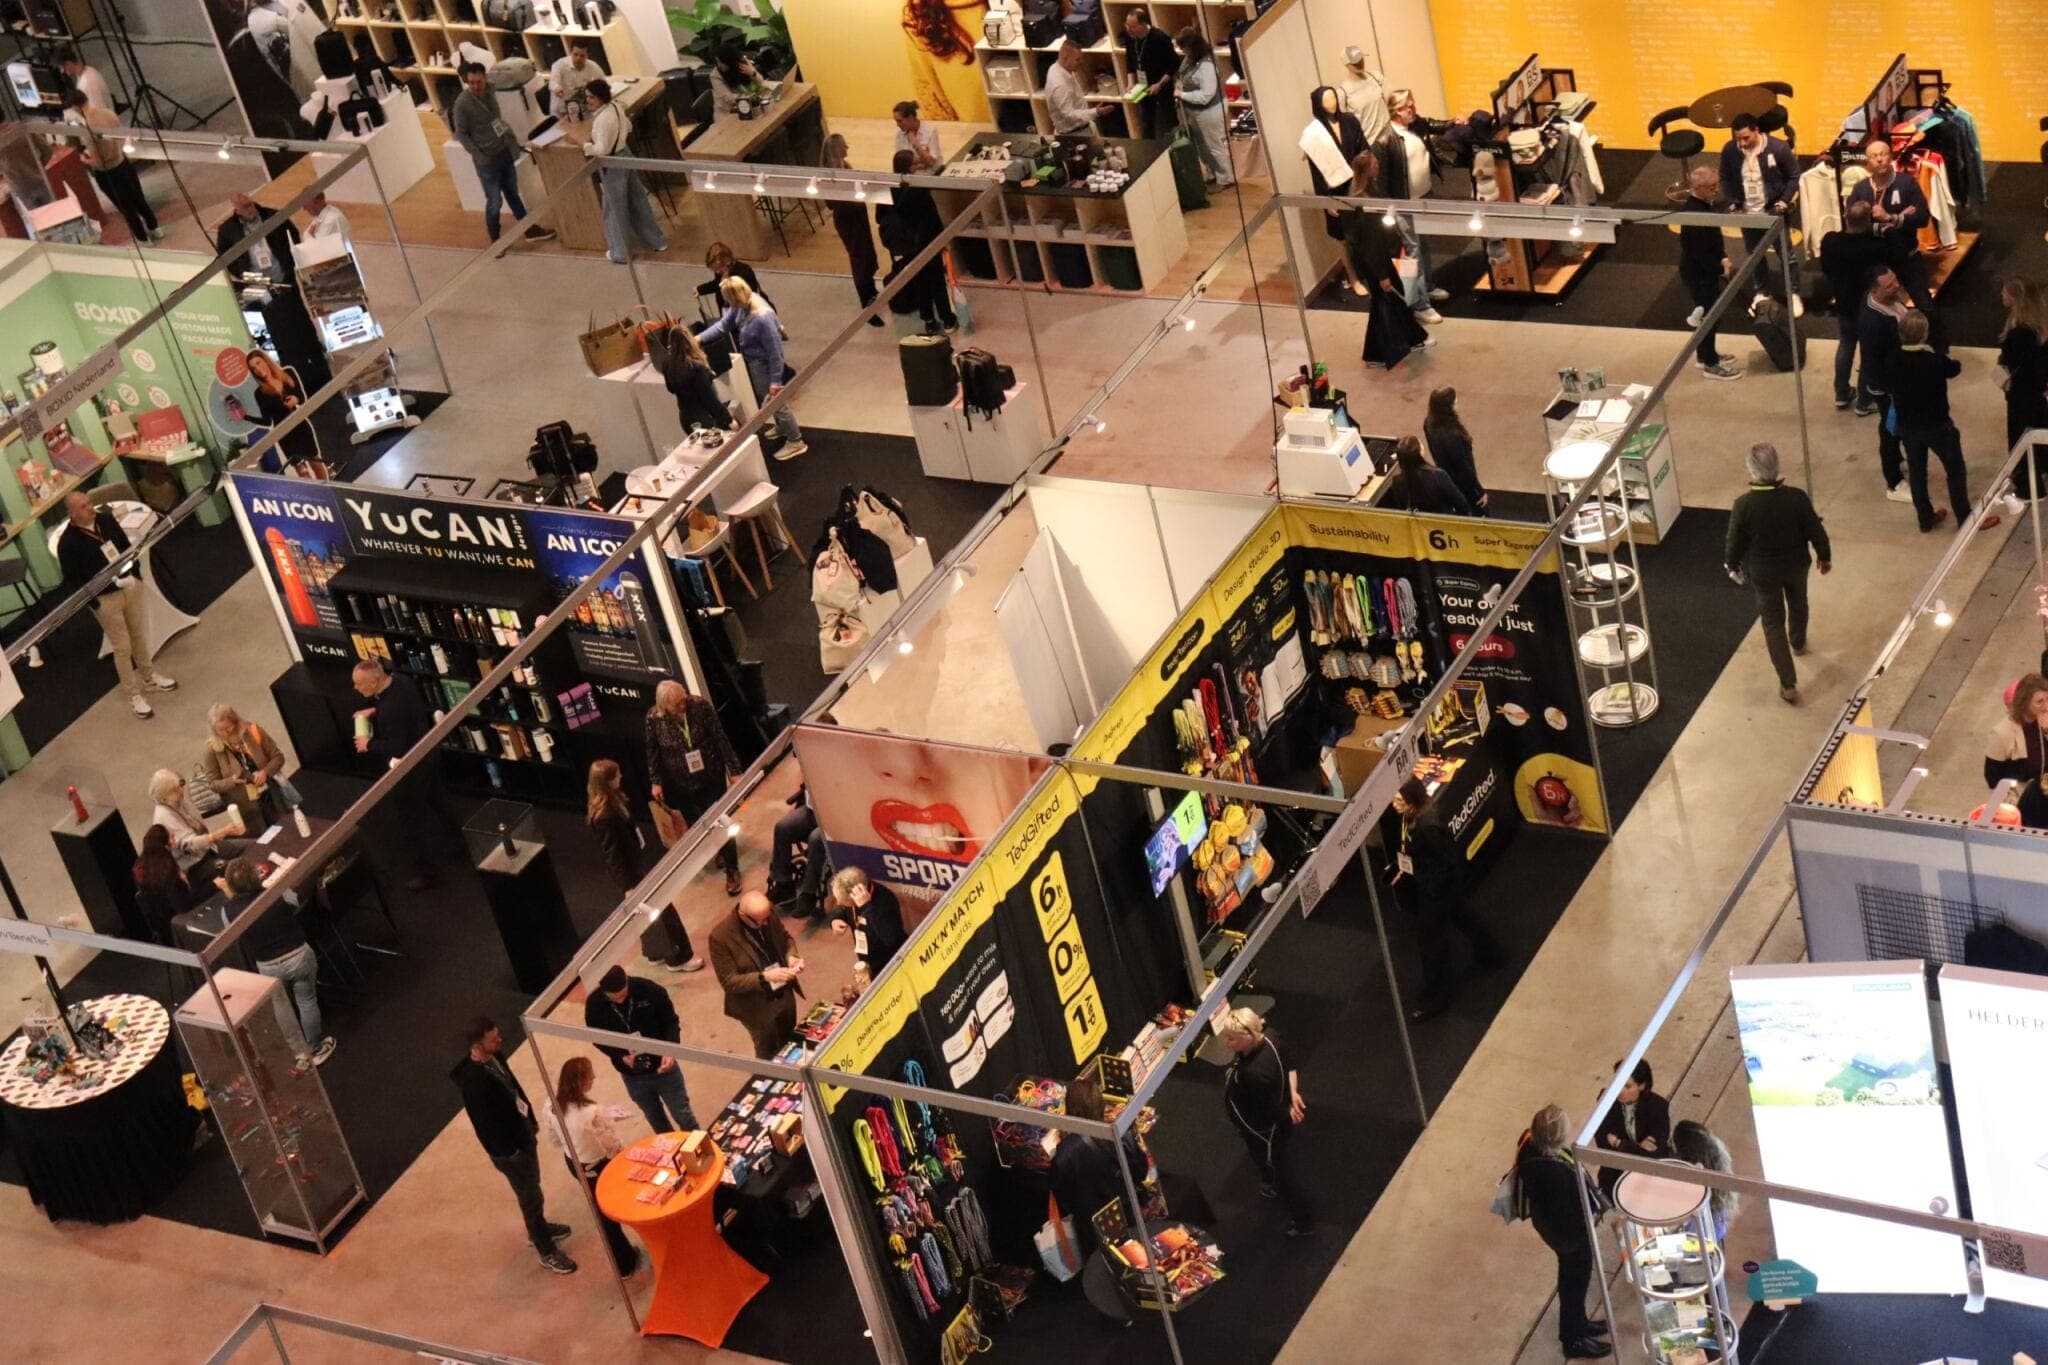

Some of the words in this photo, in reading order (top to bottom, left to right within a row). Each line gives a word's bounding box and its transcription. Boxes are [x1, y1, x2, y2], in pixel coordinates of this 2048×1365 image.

[74, 301, 144, 327] BOXID
[46, 390, 74, 416] BOXID
[73, 358, 114, 393] Nederland
[253, 498, 281, 516] AN
[282, 501, 334, 523] ICON
[345, 498, 514, 549] YuCAN
[1309, 523, 1390, 544] Sustainability
[547, 533, 577, 553] AN
[1429, 529, 1460, 550] 6h
[1474, 535, 1501, 547] Super
[361, 537, 421, 556] WHATEVER
[424, 546, 442, 558] YU
[506, 556, 535, 569] CAN
[1439, 593, 1474, 608] Your
[1478, 599, 1521, 613] orer
[1505, 615, 1535, 633] just
[1456, 640, 1465, 650] 6
[1006, 794, 1061, 866] TedGifted
[1339, 800, 1374, 852] TedGifted
